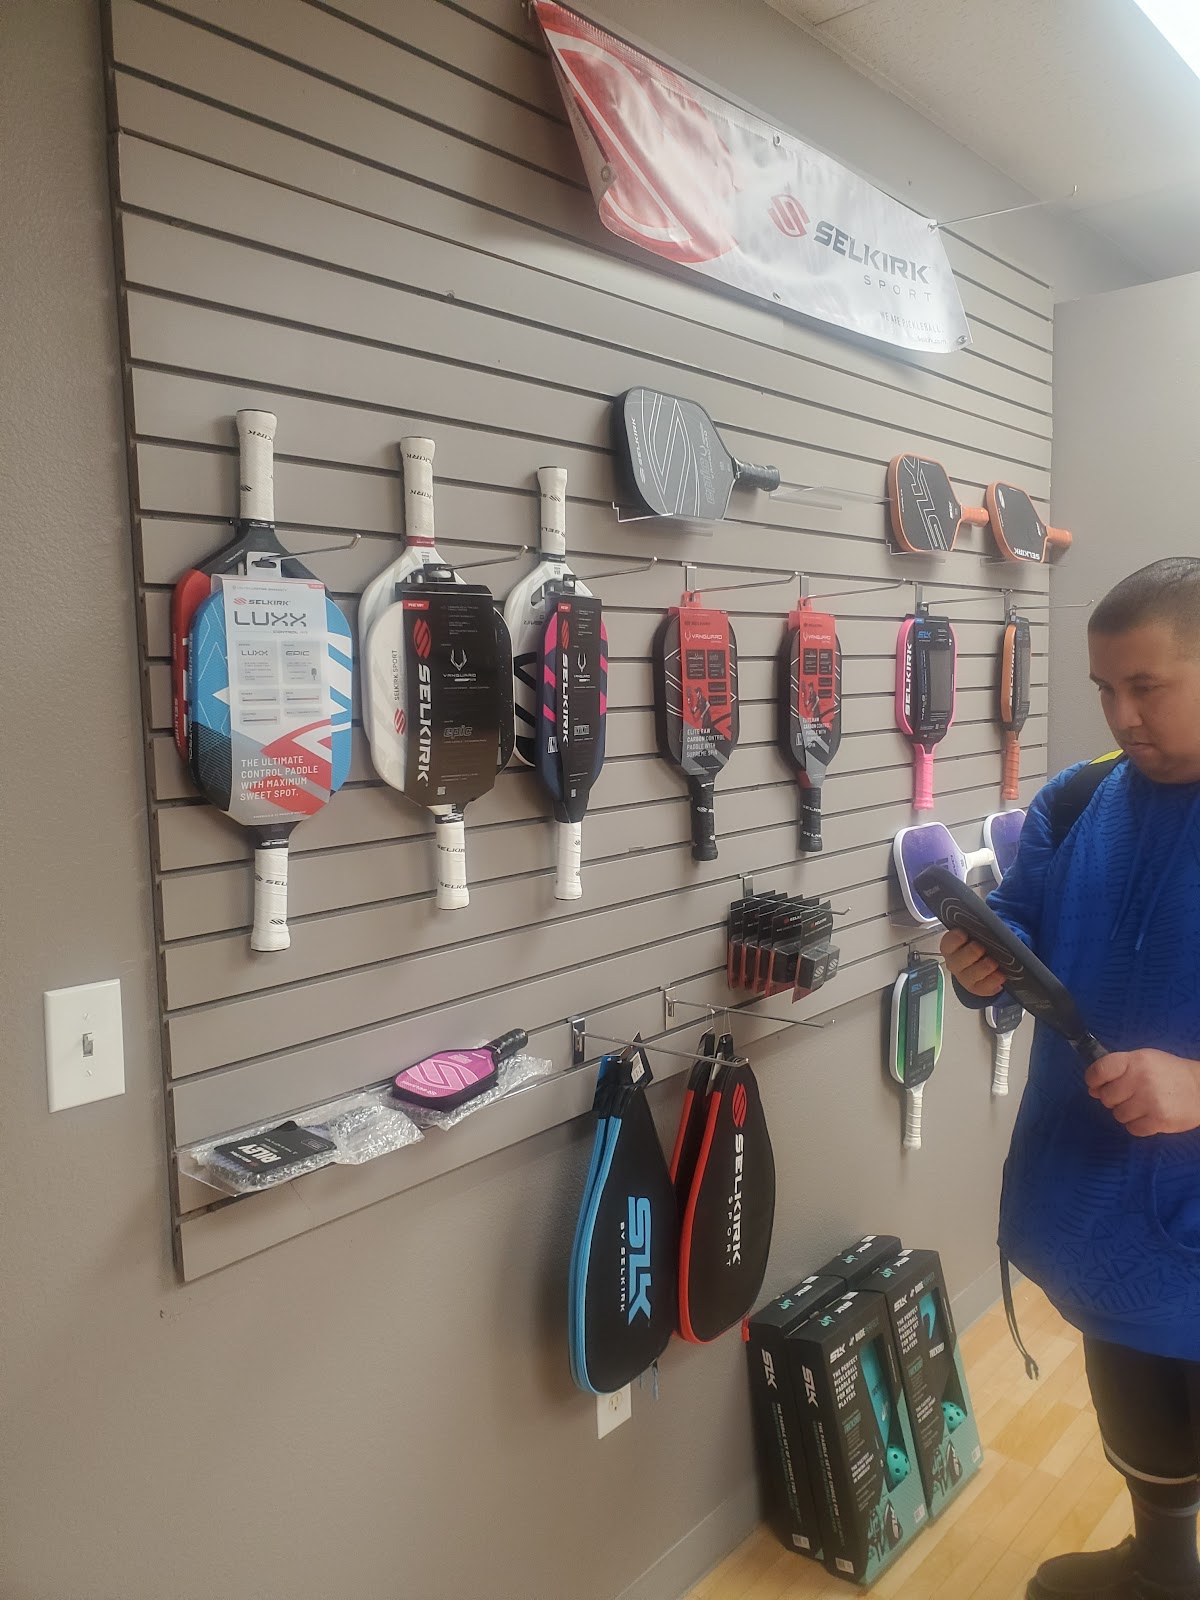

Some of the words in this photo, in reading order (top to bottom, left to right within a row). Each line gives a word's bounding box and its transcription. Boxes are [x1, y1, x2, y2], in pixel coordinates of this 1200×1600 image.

[813, 220, 930, 284] SELKIRK
[863, 274, 932, 302] SPORT
[630, 417, 643, 466] SELKIRK
[1013, 547, 1040, 560] SELKIRK
[234, 610, 307, 627] LUXX
[917, 631, 931, 639] SLK
[391, 650, 399, 673] SPORT
[417, 663, 432, 782] SELKIRK
[443, 725, 473, 738] epic
[241, 758, 259, 767] THE
[261, 755, 304, 767] ULTIMATE
[241, 768, 283, 779] CONTROL
[285, 765, 319, 776] PADDLE
[241, 780, 264, 790] WITH
[266, 777, 308, 788] MAXIMUM
[240, 790, 271, 801] SWEET
[274, 788, 299, 798] SPOT.
[237, 1144, 282, 1163] RILEY
[732, 1133, 745, 1264] SELKIRK
[620, 1222, 626, 1240] BY
[627, 1196, 652, 1325] SLK
[894, 1294, 908, 1313] SLK
[829, 1343, 846, 1363] SLK
[761, 1348, 778, 1390] SLK
[801, 1365, 819, 1408] SLK
